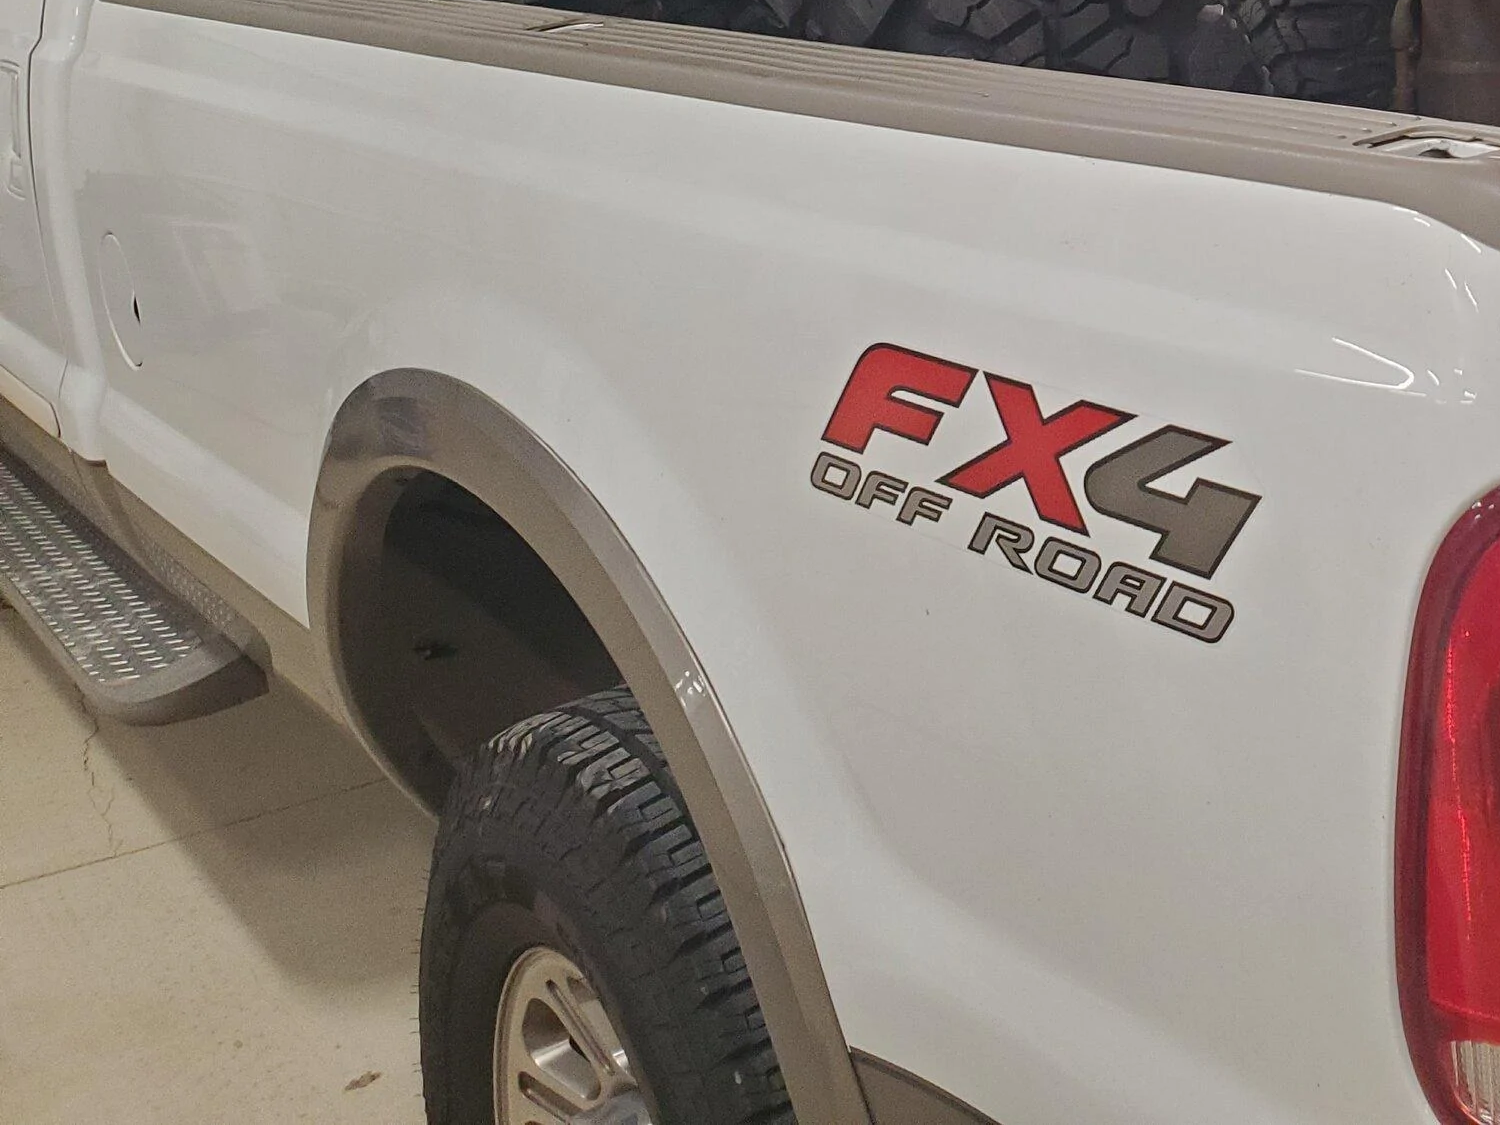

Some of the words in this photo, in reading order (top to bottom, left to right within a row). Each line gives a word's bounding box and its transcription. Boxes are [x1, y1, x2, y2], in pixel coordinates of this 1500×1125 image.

[810, 451, 953, 526] OFF
[967, 511, 1235, 643] ROAD
[821, 342, 1262, 580] FX4
